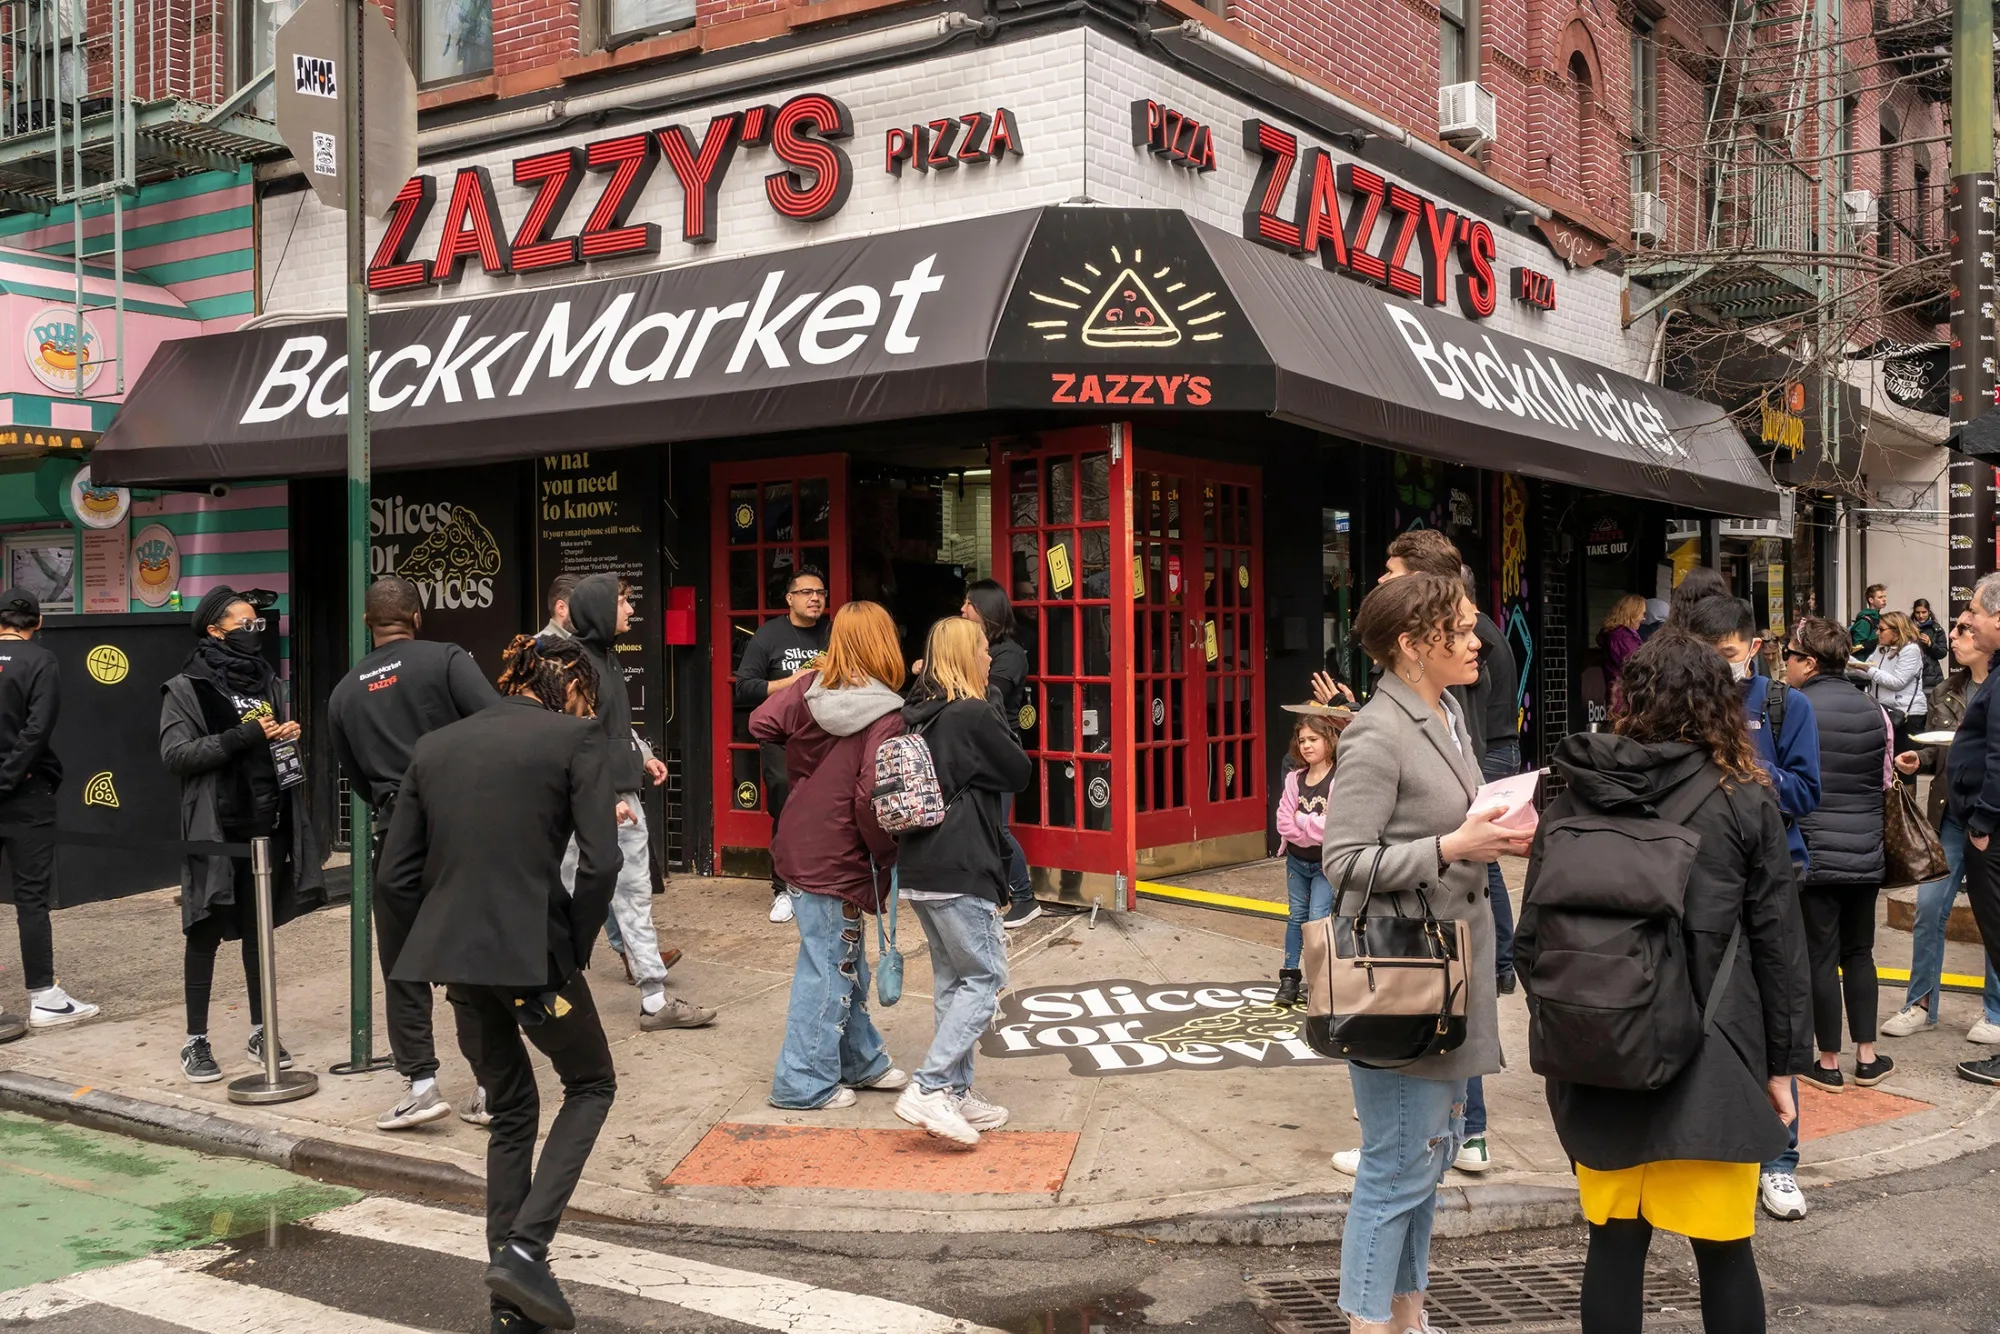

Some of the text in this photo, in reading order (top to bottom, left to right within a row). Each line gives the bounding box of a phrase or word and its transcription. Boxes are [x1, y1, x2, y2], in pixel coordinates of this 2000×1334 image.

[886, 107, 1024, 178] PIZZA
[1131, 98, 1217, 173] PIZZA
[368, 92, 853, 293] ZAZZY'S
[1243, 118, 1497, 320] ZAZZY'S
[1511, 266, 1557, 311] PIZZA
[33, 322, 94, 345] DOUBE
[1051, 373, 1212, 406] ZAZZY'S
[542, 470, 618, 502] you need
[542, 499, 618, 521] to know:
[564, 525, 604, 537] smartphone
[370, 543, 400, 575] or
[1585, 542, 1628, 557] TAKE OUT
[614, 643, 642, 652] tphones
[784, 647, 819, 660] Slices
[1588, 700, 1607, 722] Bac
[1021, 985, 1284, 1022] Slices
[996, 1019, 1145, 1053] for
[1078, 1030, 1325, 1072] Devi
